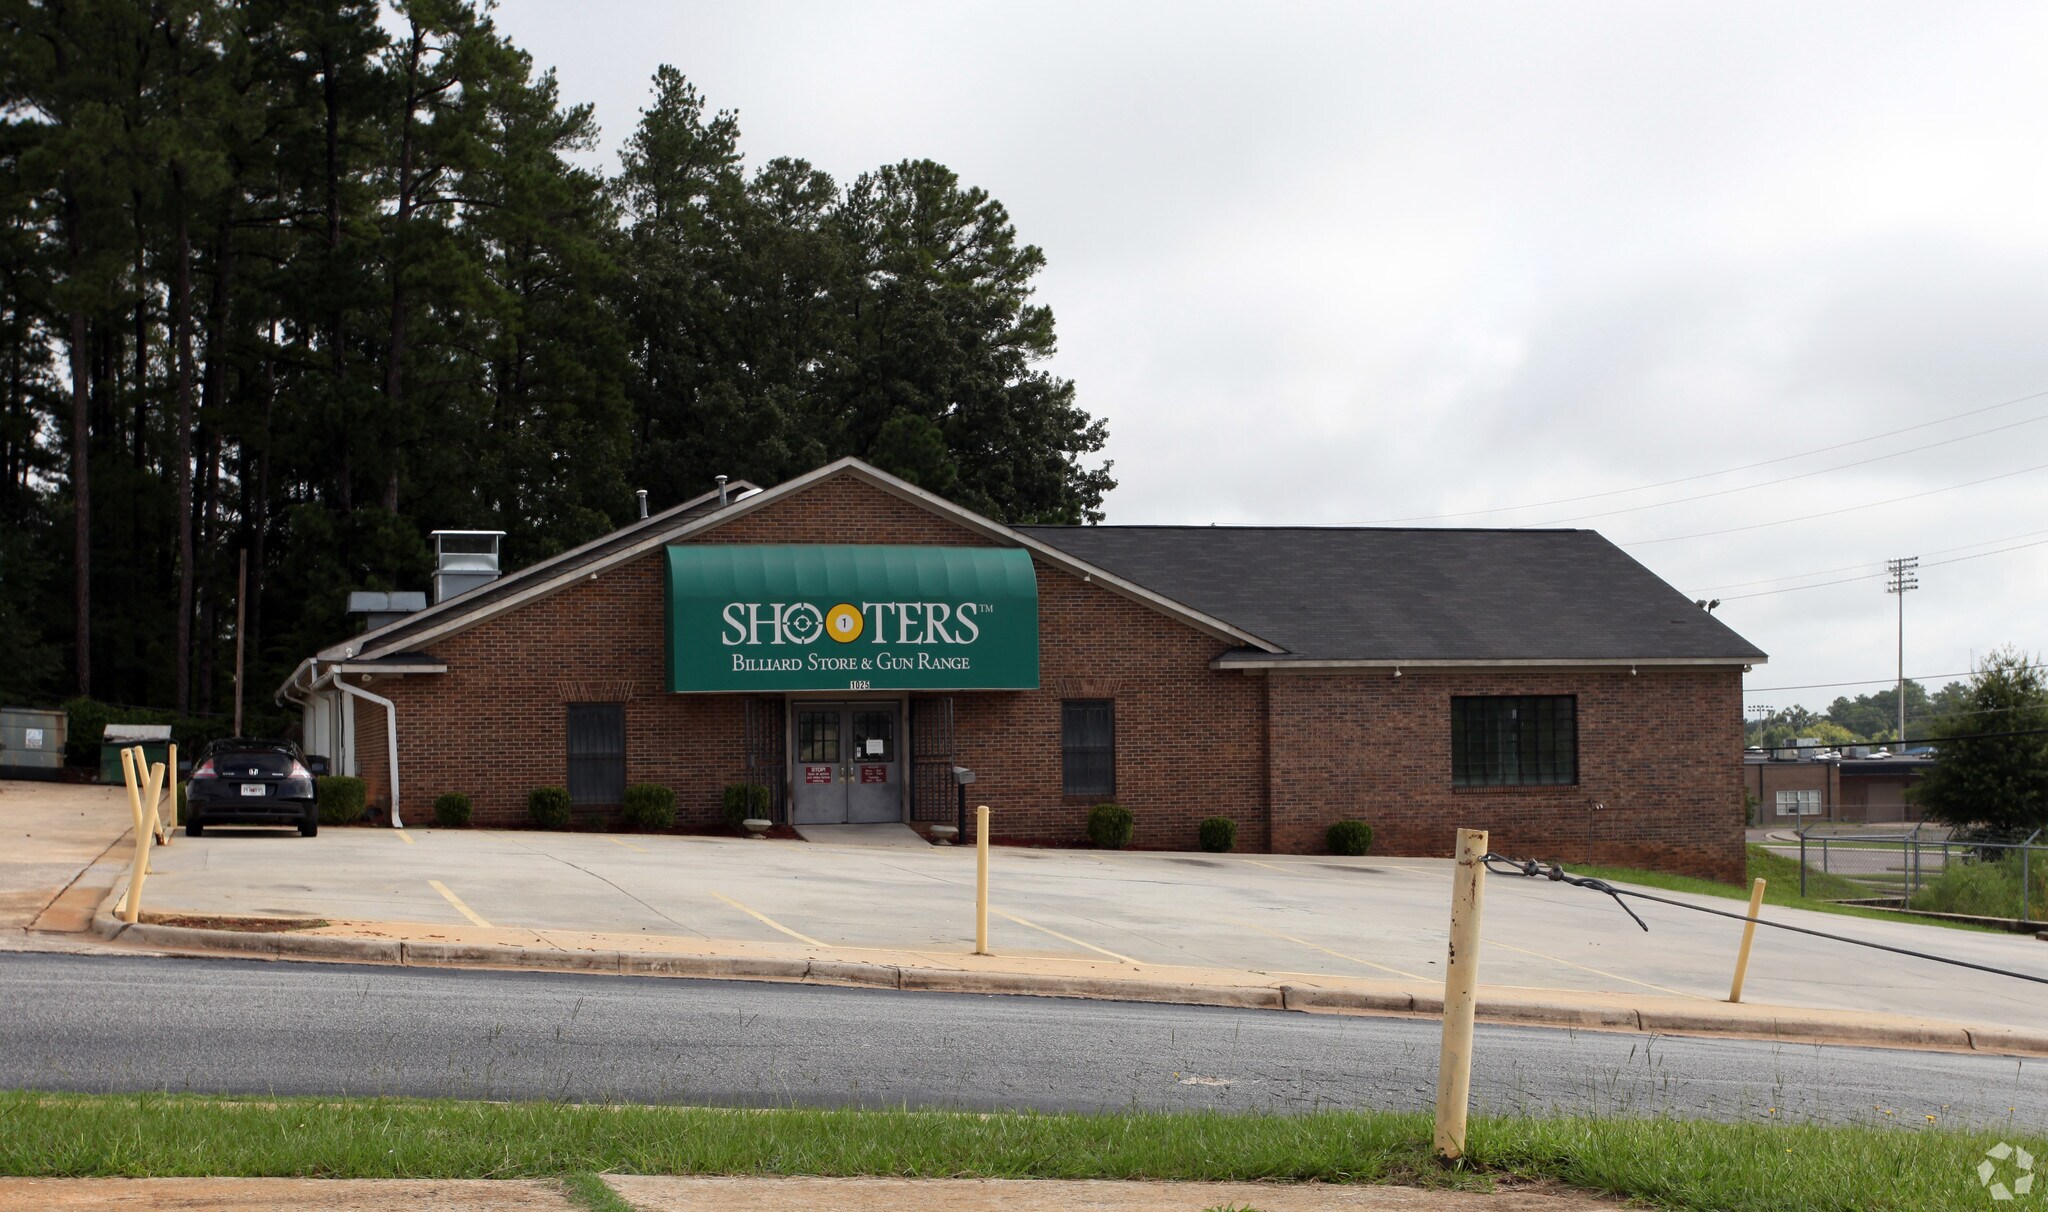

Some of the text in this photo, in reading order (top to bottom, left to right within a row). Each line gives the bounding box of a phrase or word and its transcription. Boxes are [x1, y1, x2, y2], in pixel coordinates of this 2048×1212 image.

[722, 602, 979, 645] SHOOTERS
[732, 652, 971, 671] BILLIARD STORE & GUN RANGE
[851, 680, 870, 689] 1025
